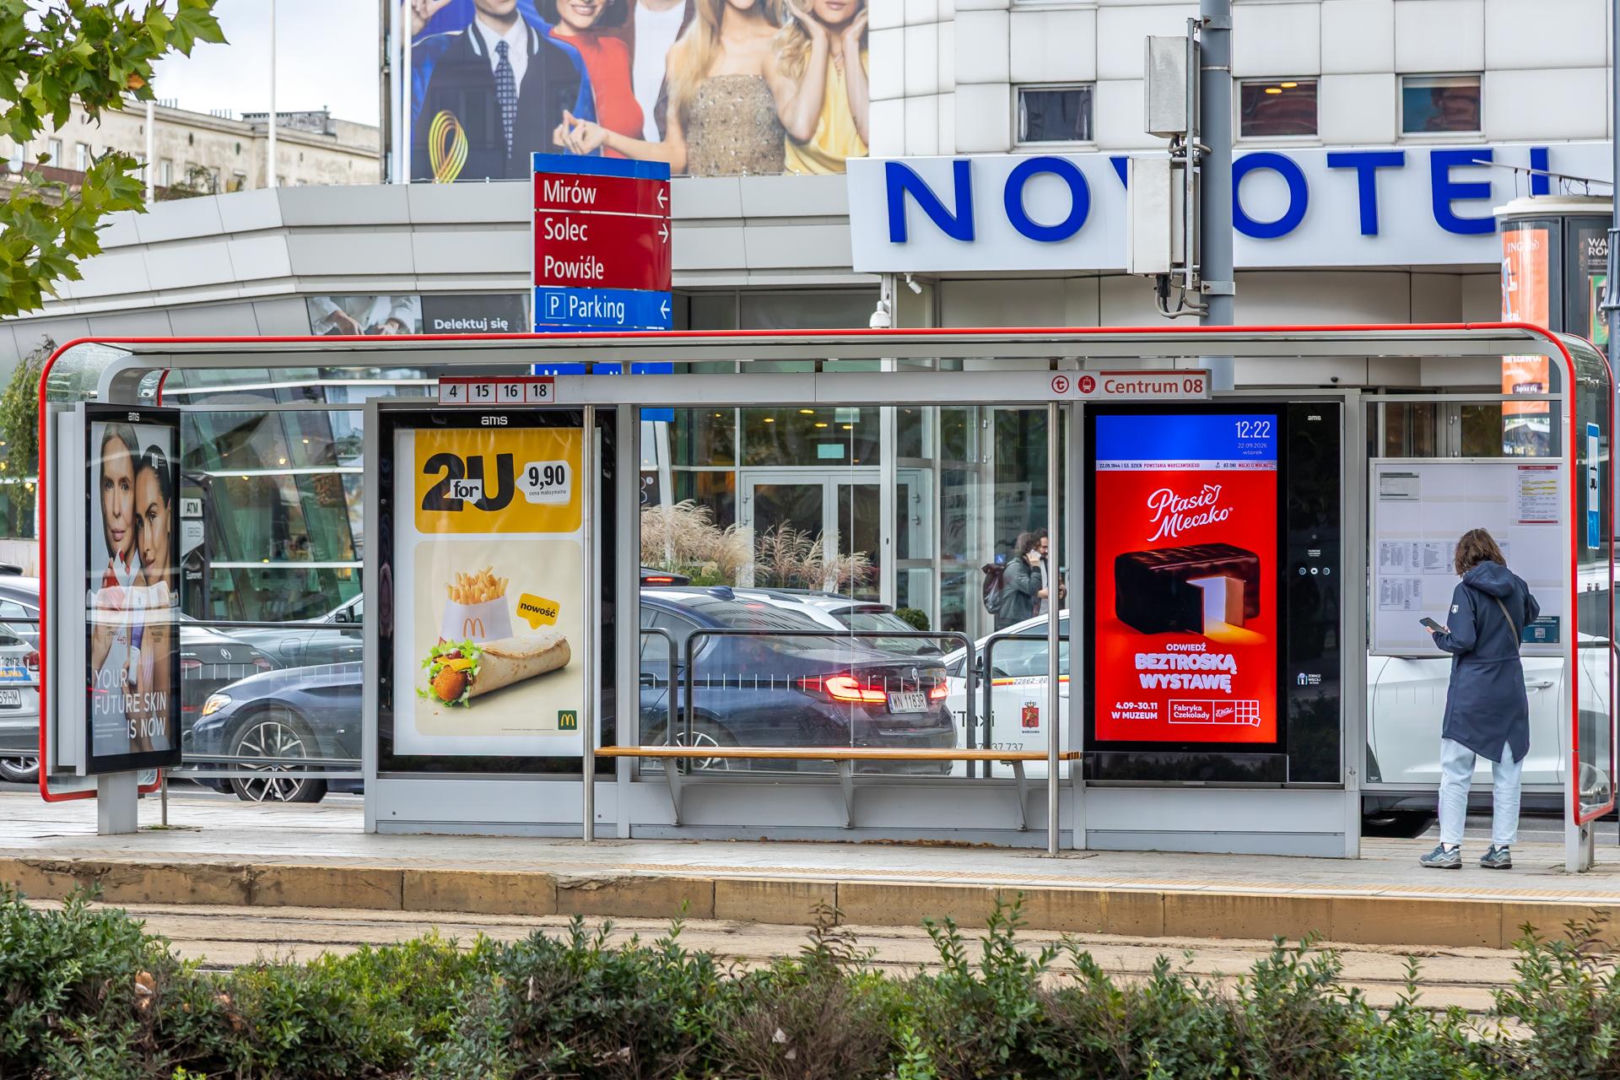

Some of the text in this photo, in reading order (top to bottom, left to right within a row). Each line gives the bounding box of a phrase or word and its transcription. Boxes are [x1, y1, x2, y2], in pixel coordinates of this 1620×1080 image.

[543, 179, 597, 205] Mirów
[886, 146, 1550, 243] NOOTE
[544, 217, 588, 241] Solec
[544, 255, 604, 280] Powiśle
[569, 295, 625, 325] Parking
[434, 317, 509, 331] Delektuj się
[449, 385, 458, 398] 4
[475, 385, 489, 398] 15
[504, 385, 518, 398] 16
[533, 384, 547, 397] 18
[1104, 379, 1179, 394] Centrum
[1183, 379, 1204, 394] 08
[481, 416, 508, 426] ams
[1235, 421, 1271, 439] 12:22
[422, 453, 465, 511] 2
[453, 481, 479, 498] for
[529, 465, 565, 490] 9,90
[186, 502, 199, 514] ATM
[1147, 484, 1222, 522] Ptasie
[1147, 505, 1229, 542] Mleczko
[520, 601, 556, 618] nowość
[1166, 642, 1206, 651] ODWIEDŹ
[1135, 653, 1237, 674] BEZTROSKĄ
[95, 668, 128, 689] YOUR
[1139, 674, 1232, 693] WYSTAWĘ
[94, 691, 167, 715] FUTURE SKIN
[1174, 704, 1202, 712] Fabryka
[1111, 712, 1158, 720] W MUZEUM
[1173, 712, 1210, 720] Czekolady
[127, 719, 137, 739] IS
[140, 717, 166, 738] NOW
